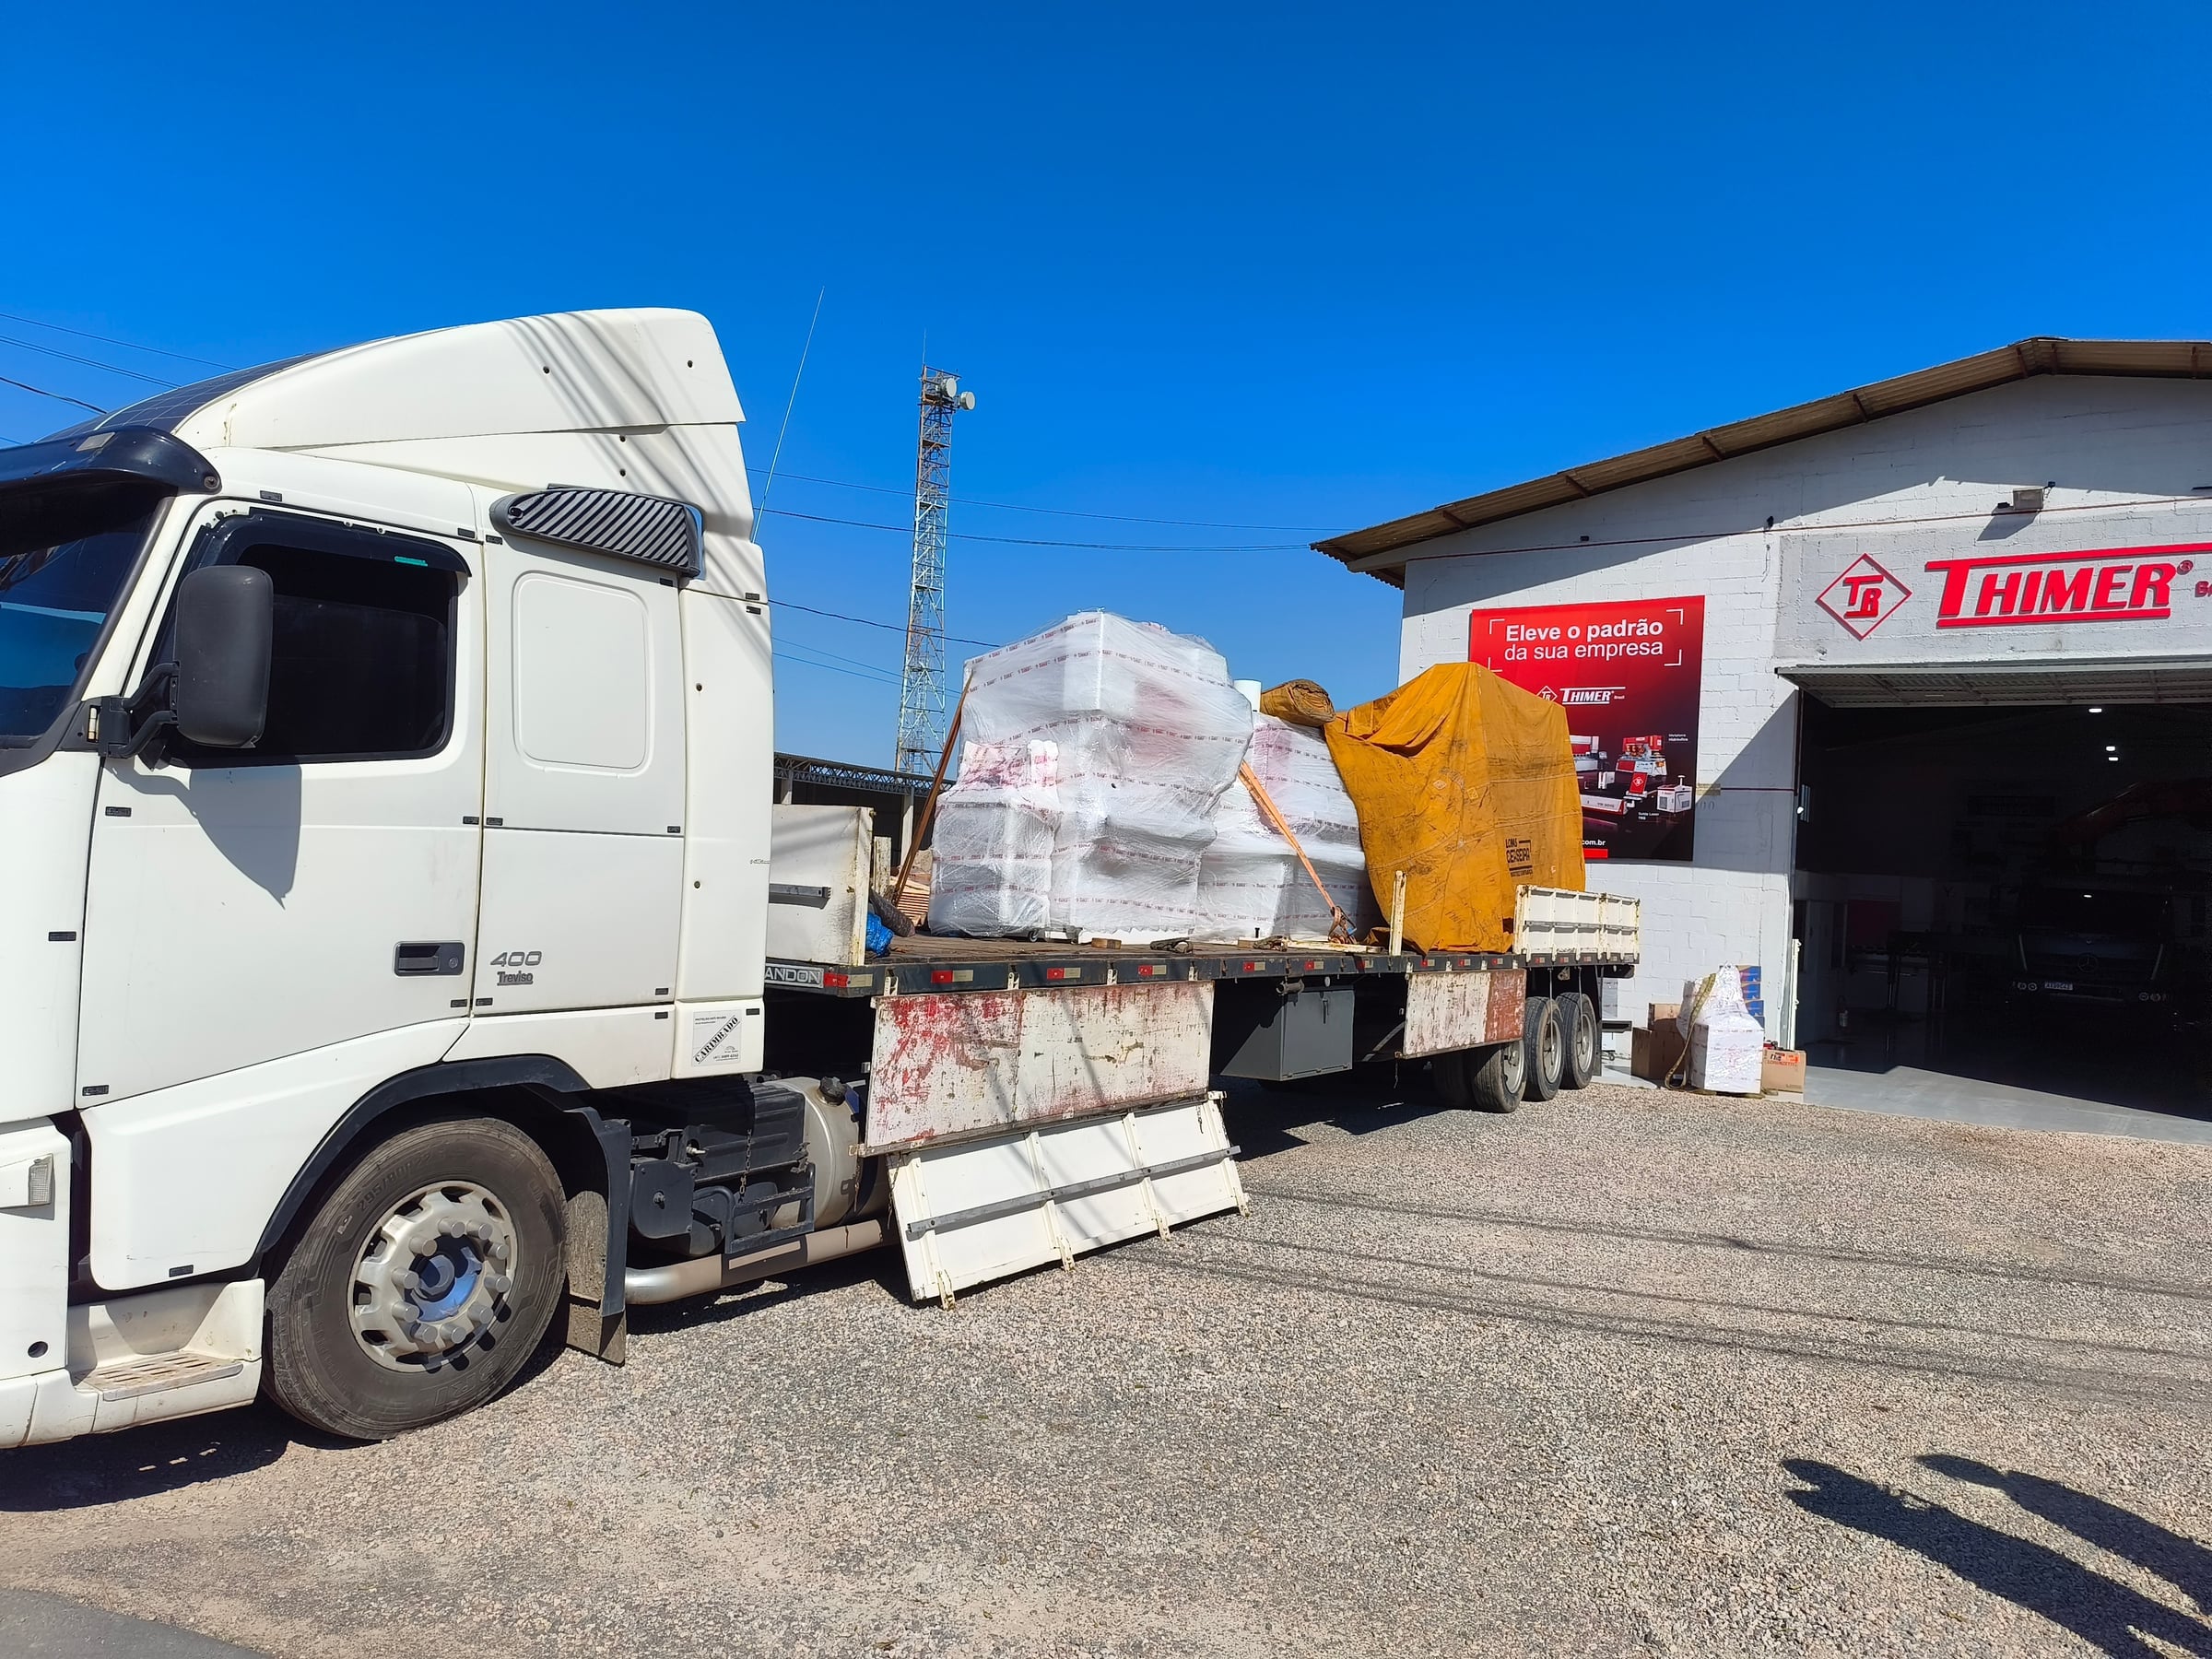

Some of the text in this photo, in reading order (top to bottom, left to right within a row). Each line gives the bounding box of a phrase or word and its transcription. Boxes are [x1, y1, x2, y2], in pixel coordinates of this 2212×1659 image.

[1505, 618, 1664, 642] Eleve o padrão
[1504, 641, 1664, 661] da sua empresa
[489, 951, 542, 967] 400
[497, 970, 534, 985] Treviso
[694, 1016, 738, 1063] CARIMBADO
